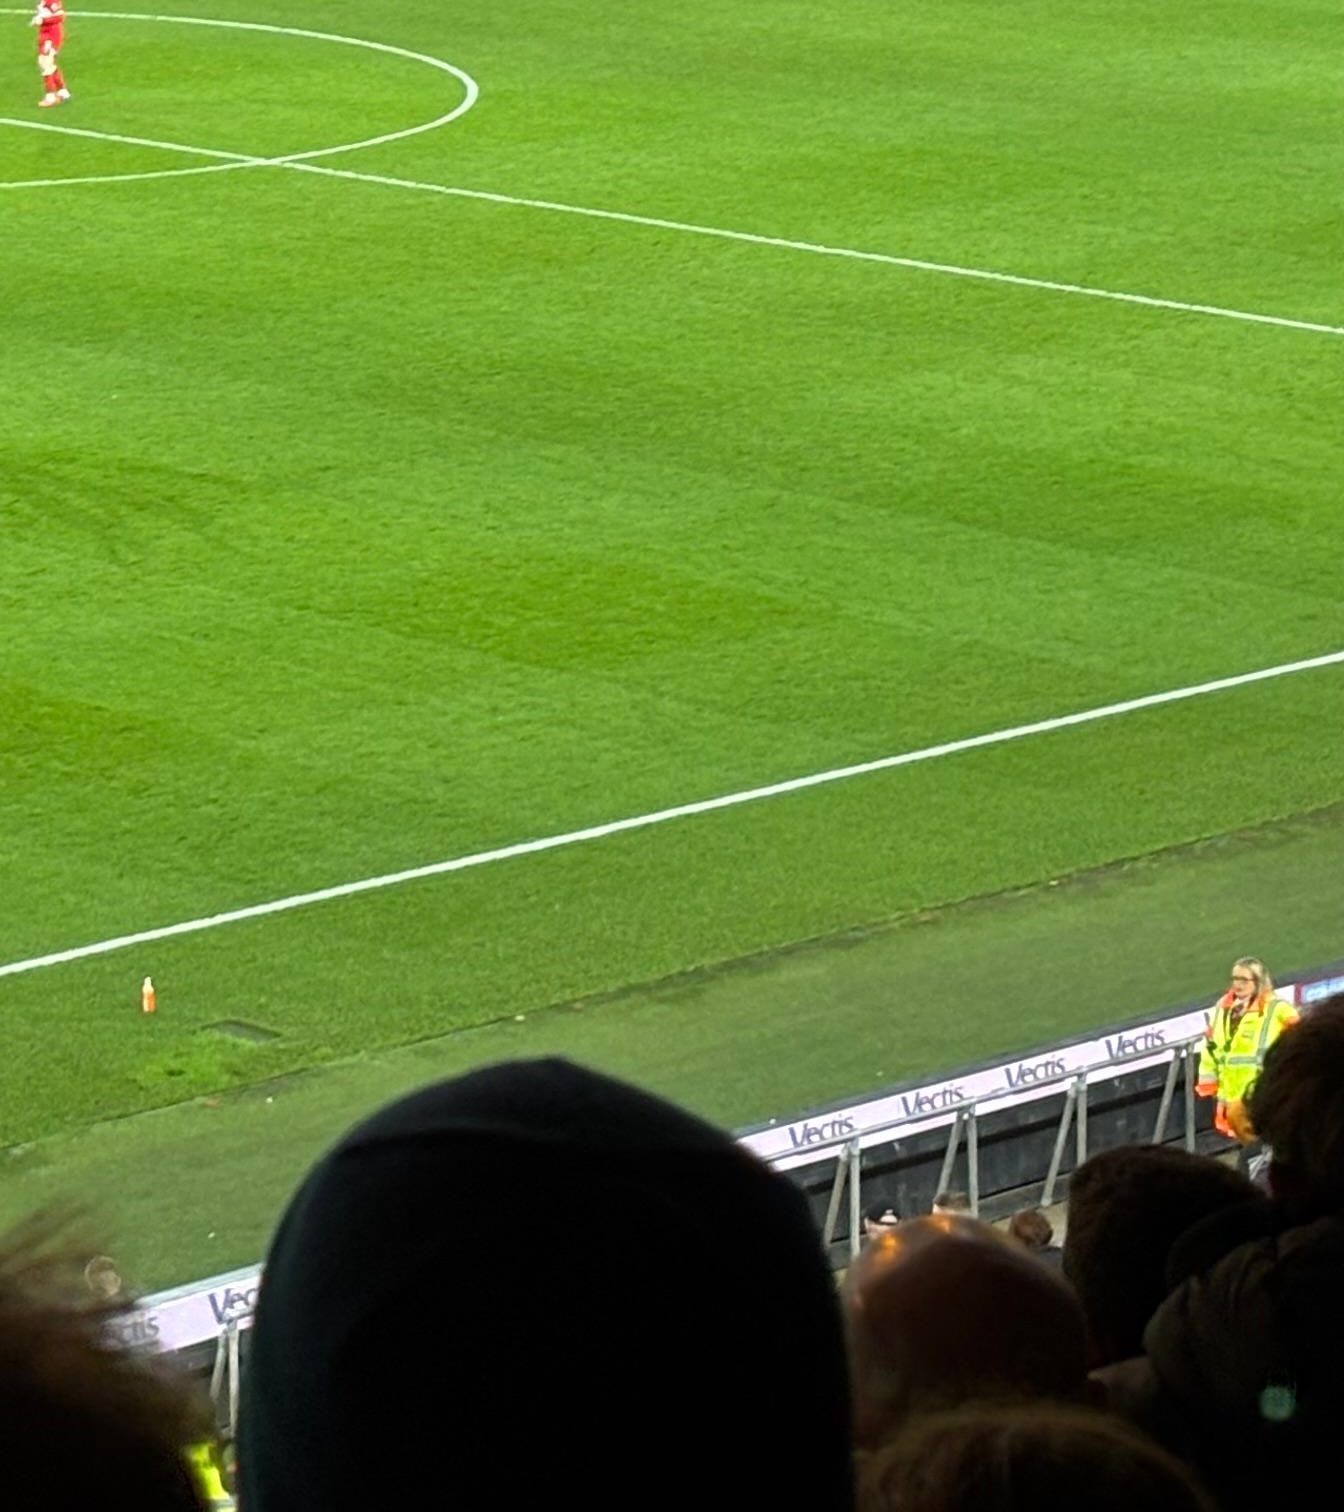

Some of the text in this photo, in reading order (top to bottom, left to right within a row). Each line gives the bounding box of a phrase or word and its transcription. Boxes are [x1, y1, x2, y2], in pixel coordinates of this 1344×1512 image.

[1105, 1027, 1166, 1059] Vectis
[1004, 1054, 1066, 1088] Vectis
[901, 1083, 966, 1118] Vectis
[788, 1113, 855, 1148] Vectis
